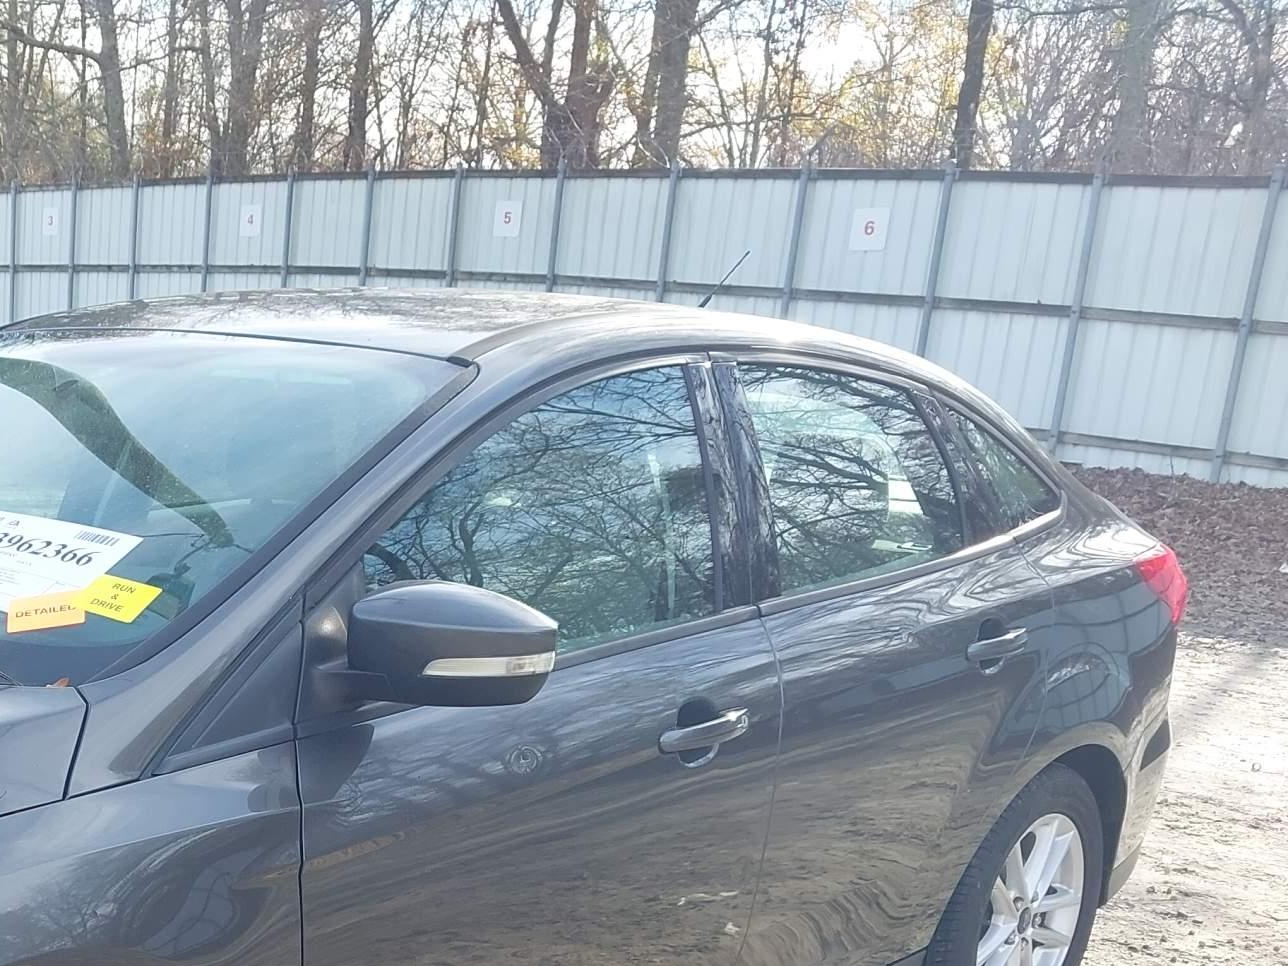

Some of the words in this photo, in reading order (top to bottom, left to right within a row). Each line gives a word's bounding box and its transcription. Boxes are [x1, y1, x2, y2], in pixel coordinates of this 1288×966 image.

[47, 215, 53, 226] 3
[247, 213, 254, 225] 4
[503, 211, 512, 225] 5
[864, 220, 875, 236] 6
[112, 583, 136, 595] RUN
[90, 598, 124, 613] DRIVE
